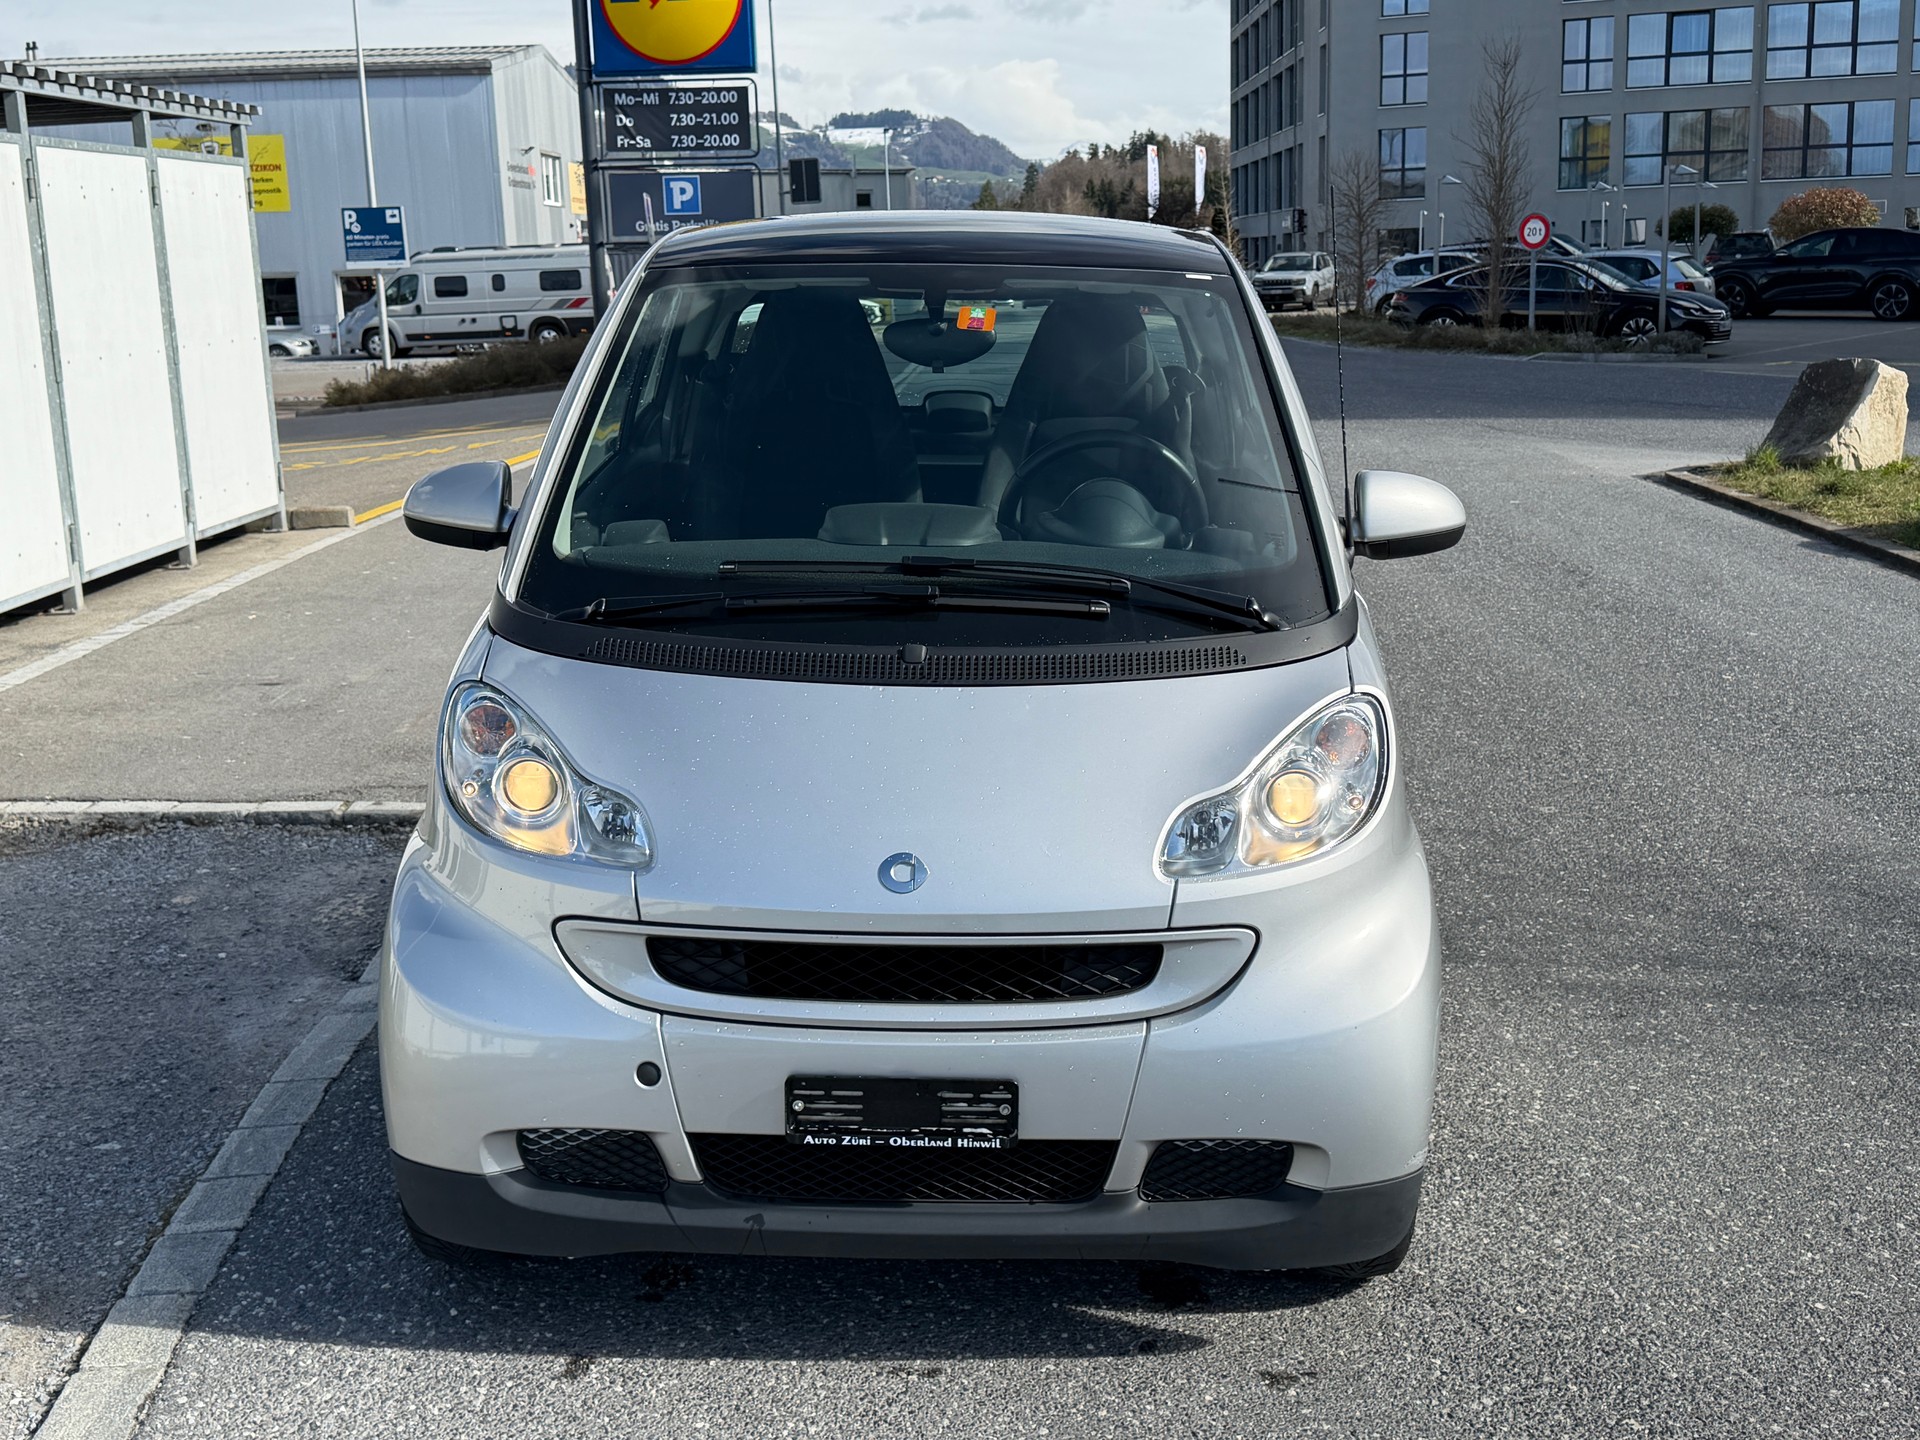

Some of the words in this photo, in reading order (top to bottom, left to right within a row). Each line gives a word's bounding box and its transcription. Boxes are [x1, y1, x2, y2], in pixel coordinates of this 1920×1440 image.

[615, 113, 634, 127] Do
[250, 163, 282, 172] TZIKON
[670, 181, 694, 209] P
[344, 210, 357, 229] P
[1527, 227, 1537, 237] 20
